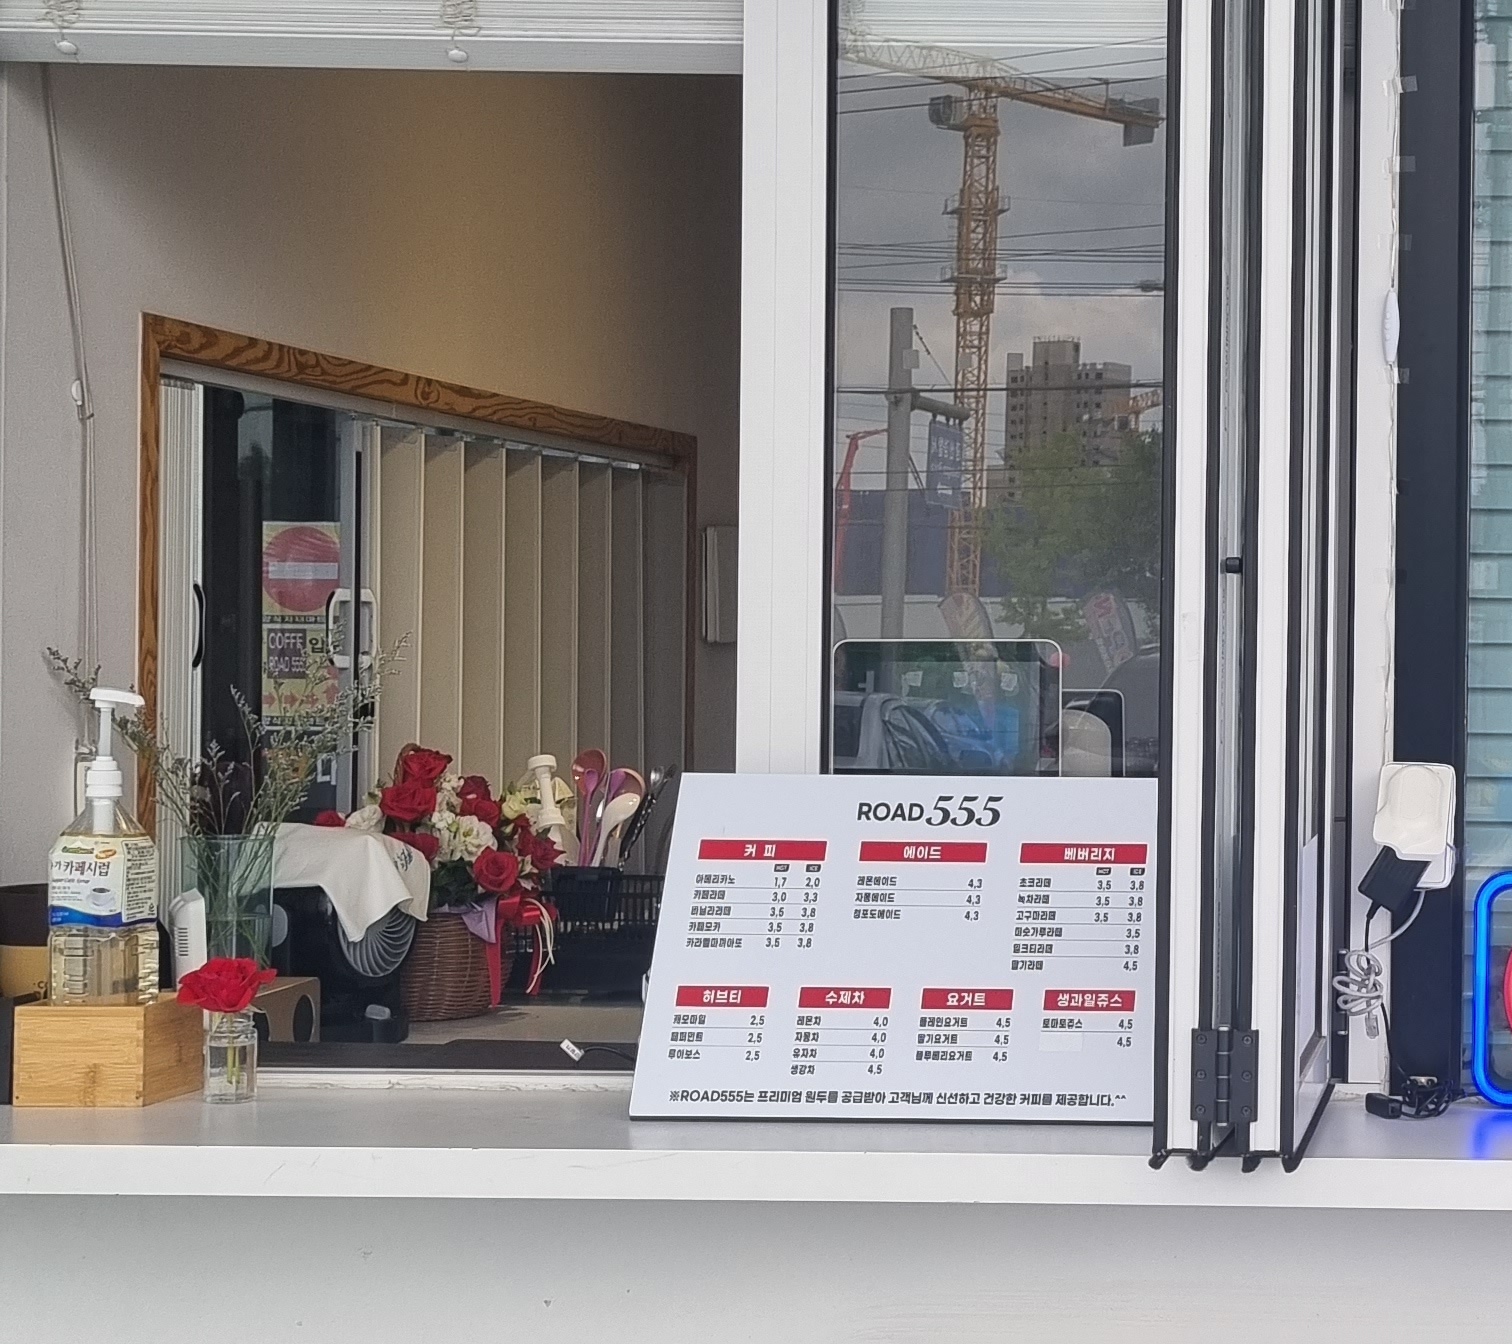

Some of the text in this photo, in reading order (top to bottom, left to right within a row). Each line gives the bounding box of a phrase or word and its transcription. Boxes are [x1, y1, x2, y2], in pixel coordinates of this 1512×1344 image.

[857, 795, 1004, 826] ROAD 555
[903, 846, 942, 859] 에이드
[1064, 847, 1115, 861] 베버리지
[774, 877, 787, 888] 1,7
[805, 877, 820, 888] 2,0
[968, 878, 983, 889] 4,3
[1097, 880, 1112, 891] 3,5
[1129, 880, 1145, 891] 3,8
[772, 892, 787, 903] 3,0
[803, 892, 818, 903] 3,3
[966, 895, 981, 905] 4,3
[1095, 896, 1110, 907] 3,5
[1128, 896, 1143, 907] 3,8
[769, 907, 785, 919] 3,5
[801, 907, 816, 919] 3,8
[964, 911, 979, 921] 4,3
[1094, 912, 1109, 923] 3,5
[1127, 912, 1142, 923] 3,8
[767, 922, 782, 933] 3,5
[799, 922, 814, 933] 3,8
[1125, 928, 1141, 939] 3,5
[765, 937, 780, 949] 3,5
[797, 937, 812, 949] 3,8
[1124, 944, 1139, 955] 3,8
[1123, 960, 1138, 971] 4,5
[703, 990, 741, 1004] 허브티
[825, 991, 865, 1005] 수제차
[946, 992, 986, 1006] 요거트
[1057, 993, 1123, 1008] 생과일쥬스
[750, 1015, 765, 1027] 2,5
[873, 1016, 888, 1028] 4,0
[996, 1017, 1011, 1028] 4,5
[1118, 1019, 1133, 1030] 4,5
[747, 1033, 762, 1044] 2,5
[871, 1032, 887, 1044] 4,0
[994, 1034, 1009, 1045] 4,5
[1117, 1037, 1132, 1047] 4,5
[745, 1050, 760, 1062] 2,5
[869, 1048, 885, 1060] 4,0
[993, 1051, 1008, 1062] 4,5
[867, 1065, 883, 1076] 4,5
[757, 1091, 802, 1103] 프리미엄
[805, 1091, 838, 1104] 원두를
[841, 1091, 886, 1104] 공급받아
[888, 1092, 933, 1105] 고객님께
[936, 1092, 980, 1105] 신선하고
[984, 1093, 1017, 1106] 건강한
[1019, 1093, 1053, 1106] 커피를
